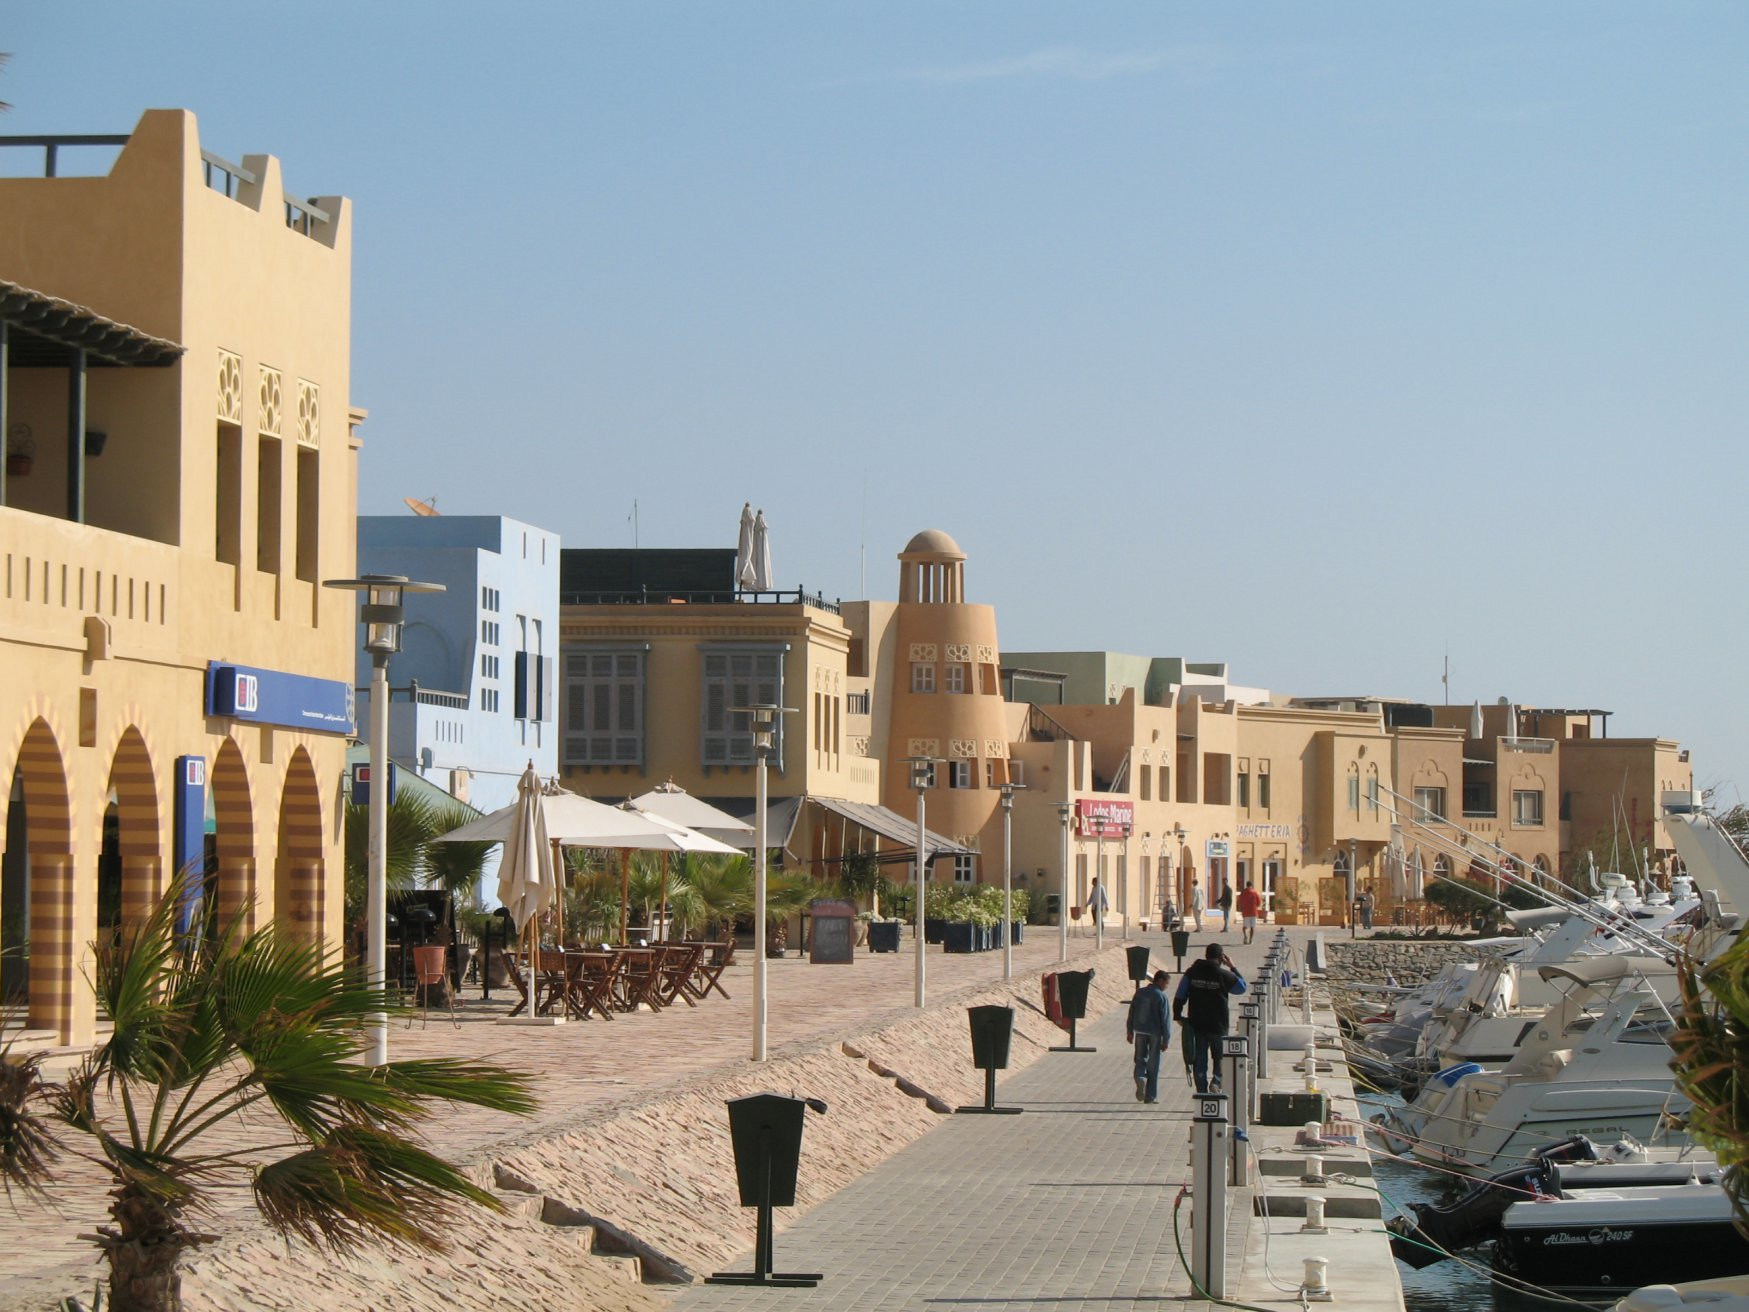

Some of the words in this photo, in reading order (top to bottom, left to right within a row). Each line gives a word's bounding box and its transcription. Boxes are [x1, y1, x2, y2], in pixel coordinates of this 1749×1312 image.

[1110, 804, 1132, 824] Marine
[1230, 1042, 1239, 1050] 18
[1204, 1102, 1217, 1114] 20
[1566, 1126, 1630, 1136] REGAL
